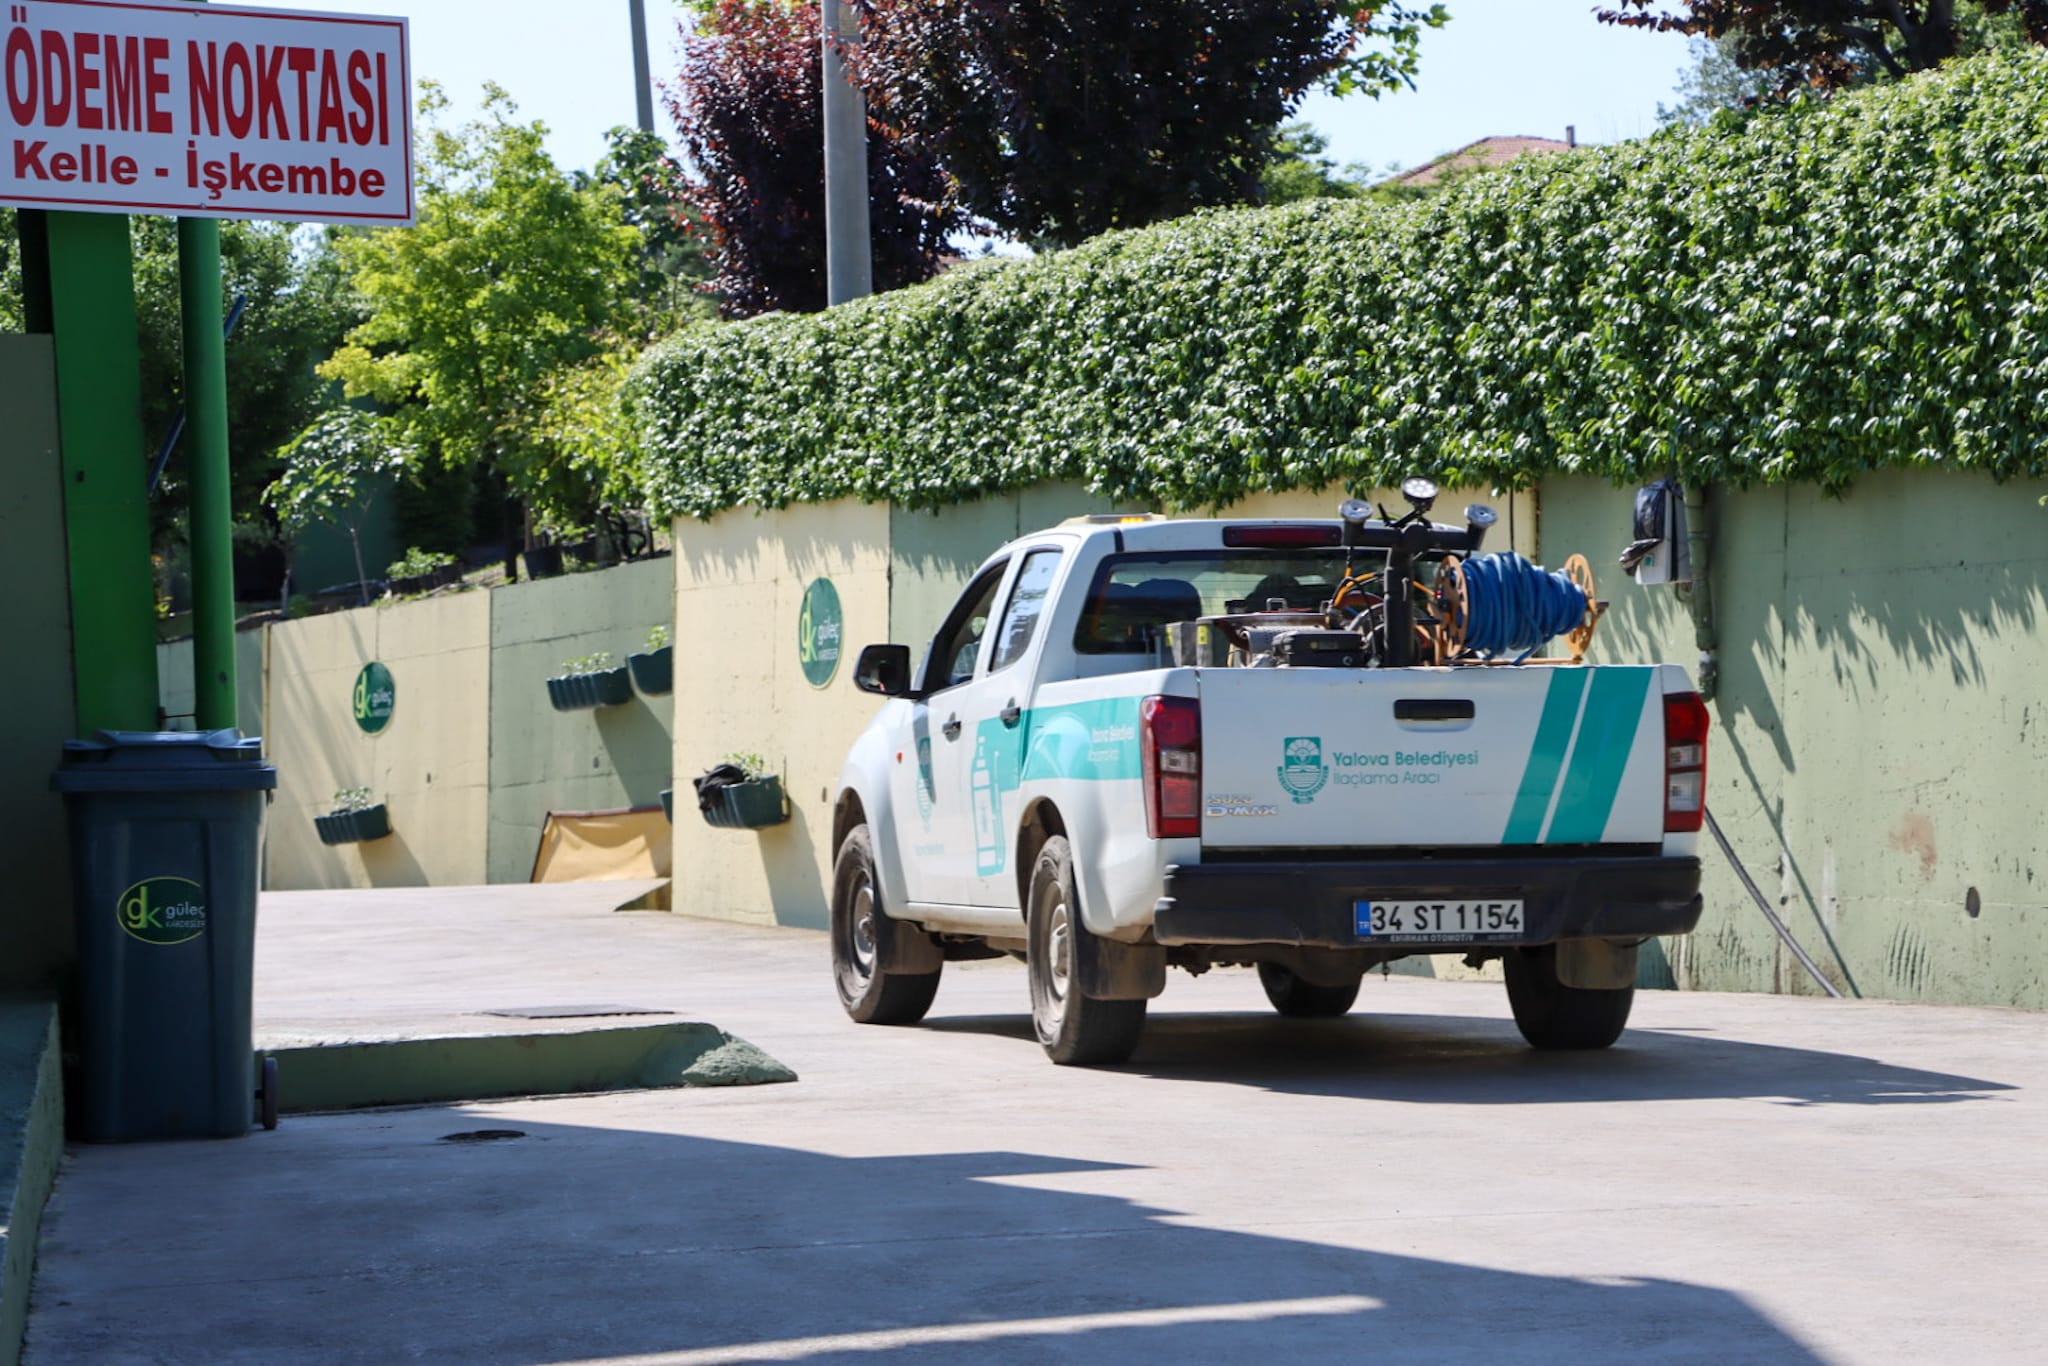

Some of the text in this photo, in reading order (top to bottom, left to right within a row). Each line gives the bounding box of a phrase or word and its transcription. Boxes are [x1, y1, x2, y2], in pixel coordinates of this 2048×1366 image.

[5, 5, 390, 146] ÖDEME NOKTASI
[13, 138, 385, 200] Kelle - İşkembe
[1333, 750, 1479, 767] Yalova Belediyesi
[1359, 921, 1369, 929] TR
[1372, 904, 1520, 931] 34 ST 1154
